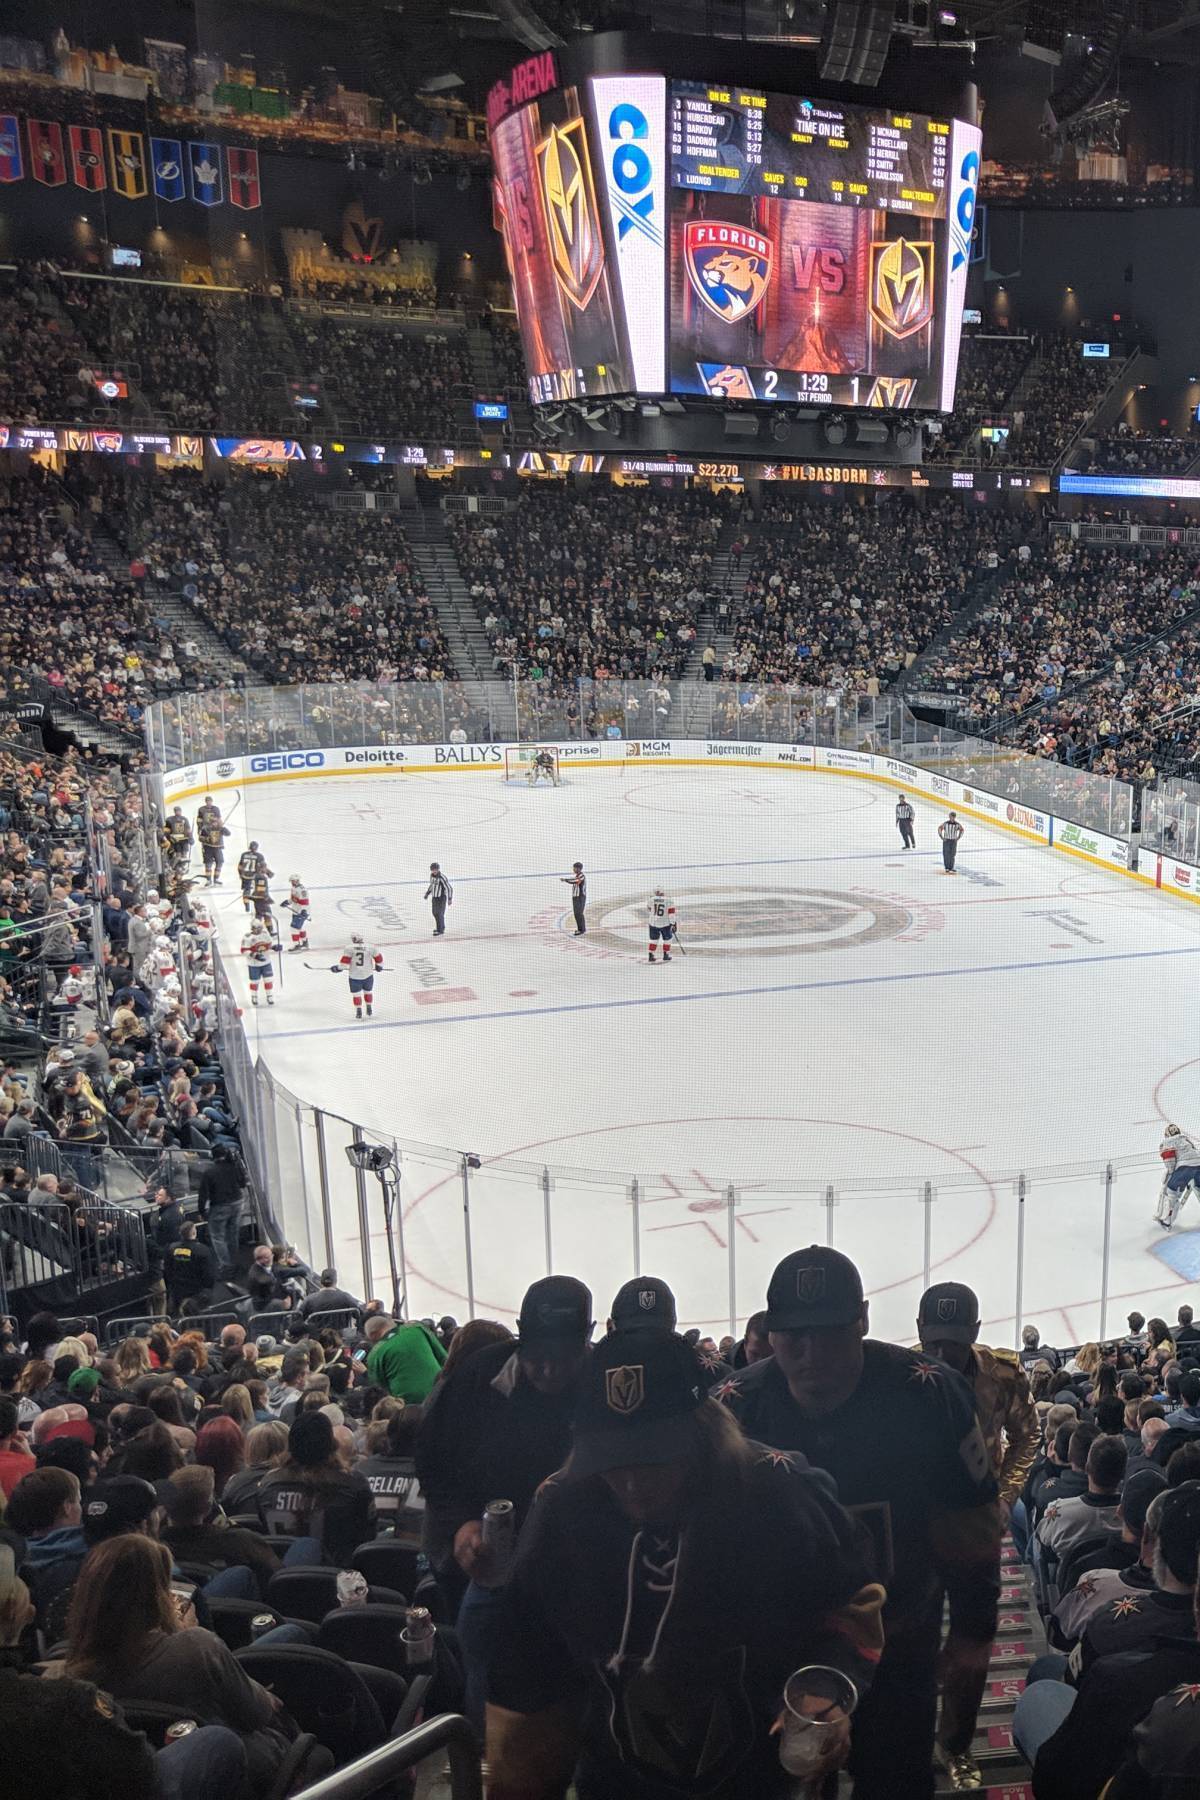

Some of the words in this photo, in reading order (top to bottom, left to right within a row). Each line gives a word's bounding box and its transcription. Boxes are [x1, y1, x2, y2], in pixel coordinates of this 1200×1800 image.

[511, 51, 556, 106] ARENA
[687, 101, 712, 113] YANDLE
[686, 124, 713, 135] BARKOV
[797, 120, 817, 134] TIME
[818, 122, 830, 136] ON
[831, 124, 845, 138] ICE
[686, 135, 717, 147] DADONOV
[686, 146, 717, 158] HOFFMAN
[877, 160, 893, 170] SMITH
[608, 103, 666, 248] COX
[699, 164, 740, 179] GOALTENDER
[686, 175, 712, 186] LUONGO
[764, 173, 784, 184] SAVES
[850, 183, 868, 195] SAVES
[697, 228, 767, 254] FLORIDA
[790, 243, 845, 293] VS
[765, 371, 778, 398] 2
[801, 374, 828, 392] 1:29
[851, 377, 859, 403] 1
[797, 391, 808, 402] 1ST
[810, 392, 832, 403] PERIOD
[20, 439, 34, 448] 2/2
[315, 446, 323, 460] 2
[407, 447, 424, 458] 1:29
[623, 461, 645, 472] 51/49
[646, 463, 674, 473] RUNNING
[675, 464, 694, 473] TOTAL
[643, 742, 671, 751] MGM
[434, 744, 502, 764] BALLY'S
[251, 752, 325, 773] GEICO
[243, 859, 256, 872] 71
[654, 904, 665, 916] 16
[355, 952, 364, 967] 3
